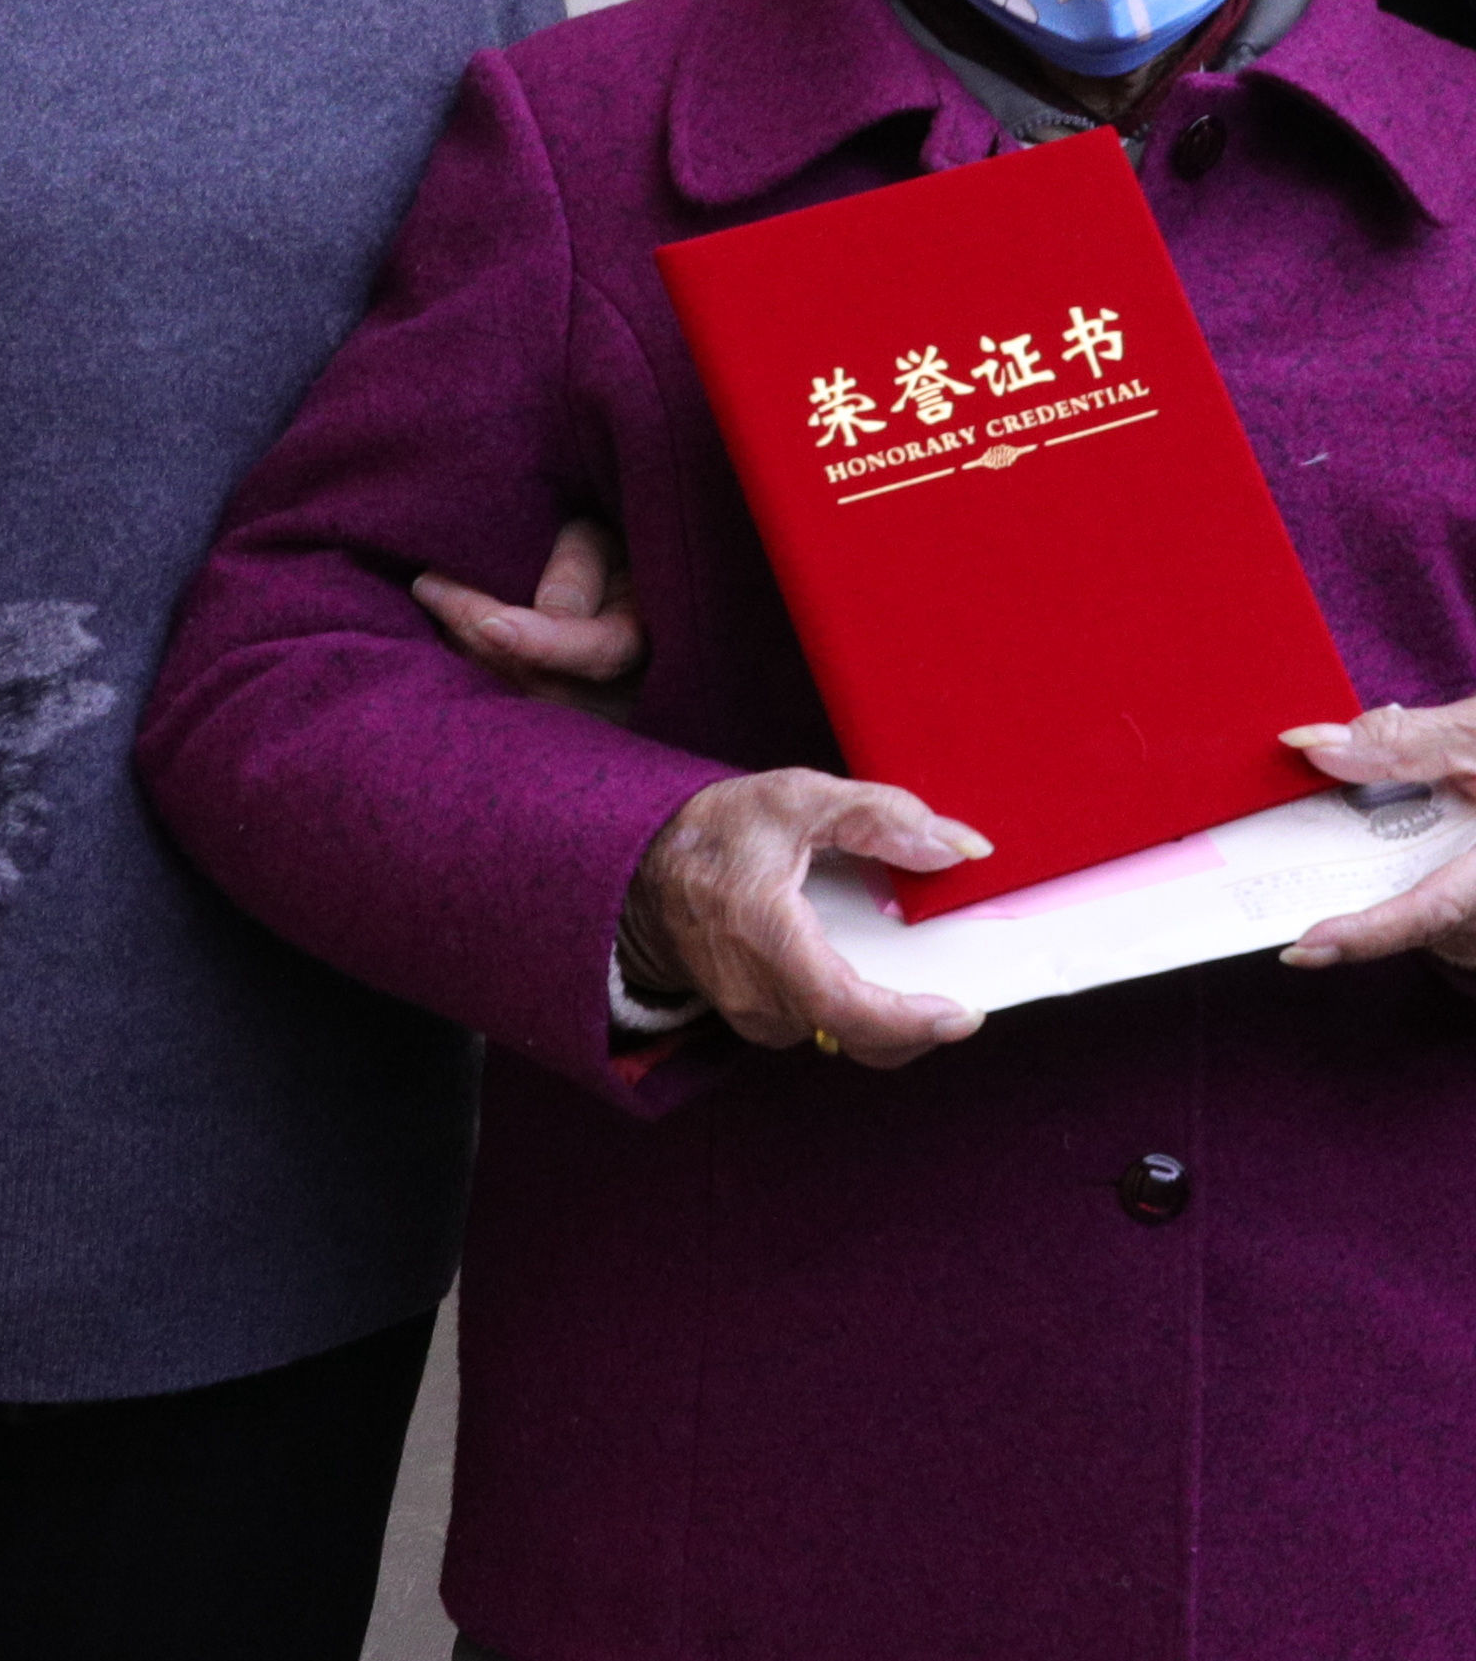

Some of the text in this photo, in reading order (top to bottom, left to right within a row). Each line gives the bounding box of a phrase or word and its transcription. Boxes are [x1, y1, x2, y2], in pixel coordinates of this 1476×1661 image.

[807, 305, 1125, 448] 荣誉证书
[824, 377, 1151, 484] HONORARY CREDENTIAL
